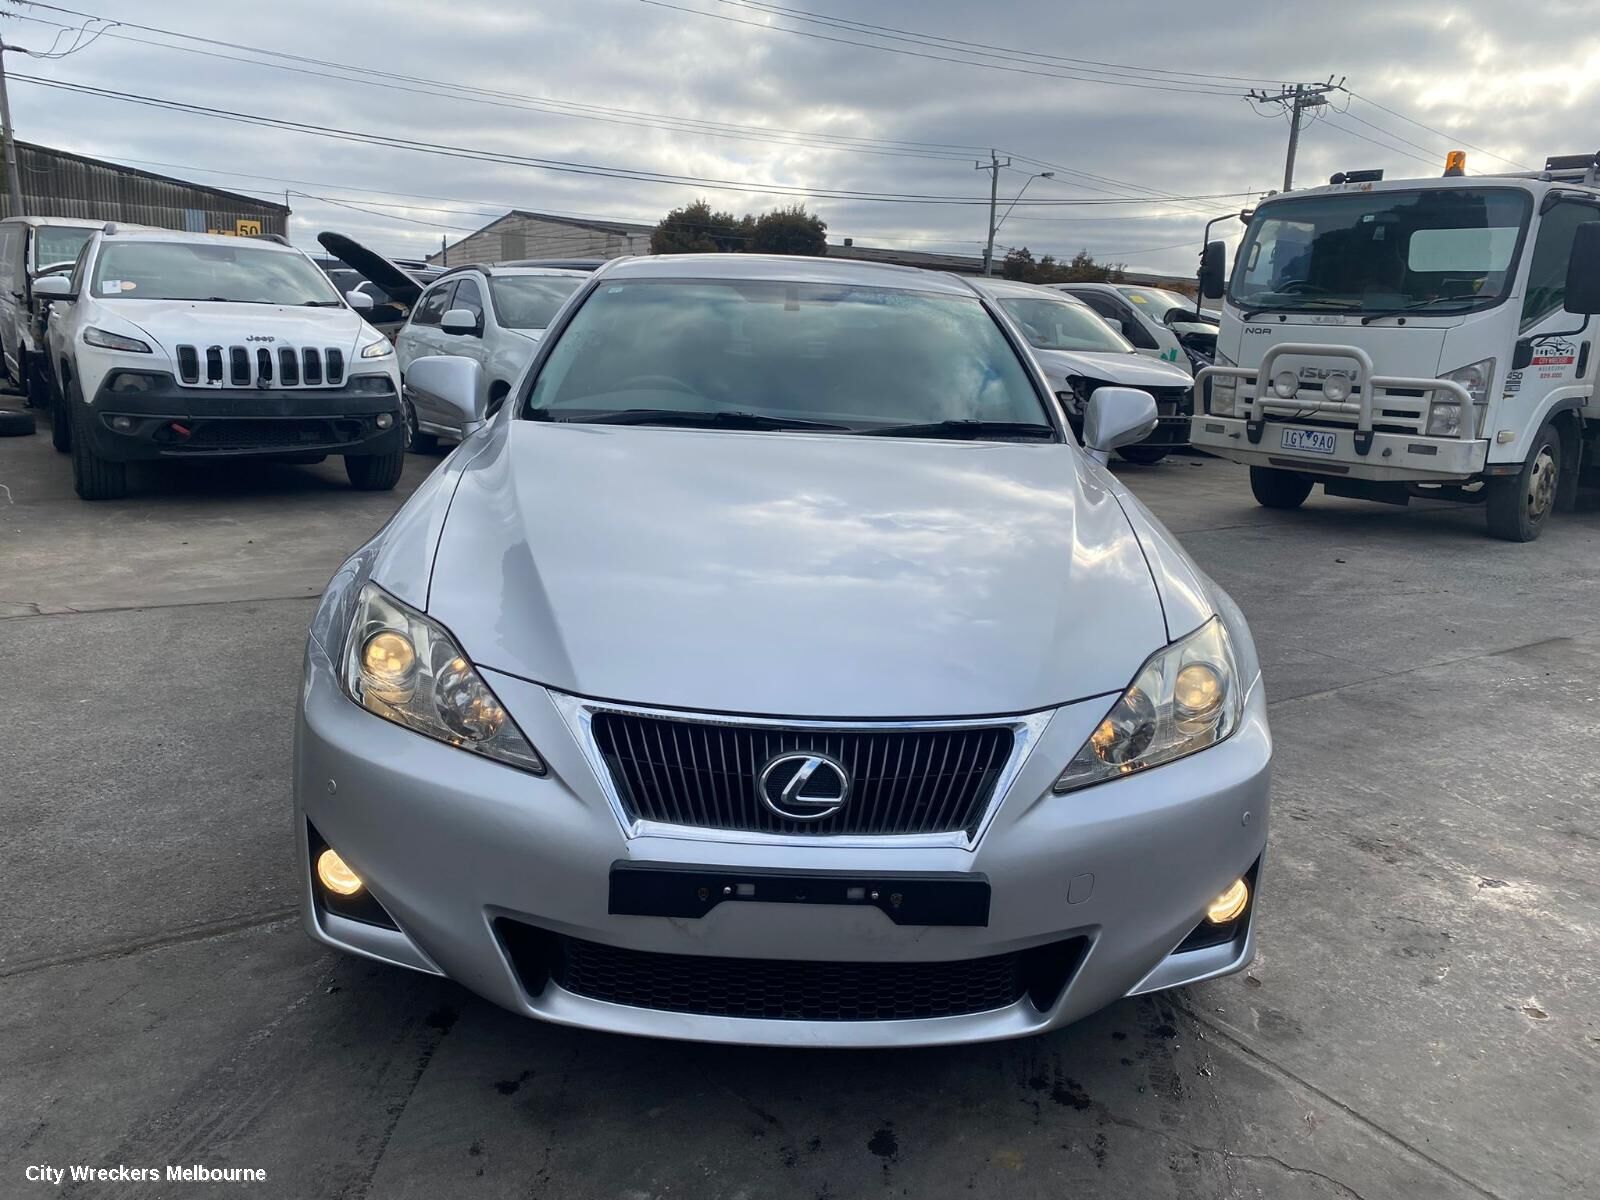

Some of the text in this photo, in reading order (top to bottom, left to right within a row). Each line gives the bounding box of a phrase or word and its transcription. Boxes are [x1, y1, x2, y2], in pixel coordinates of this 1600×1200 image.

[239, 225, 259, 236] 50
[246, 335, 275, 343] Jeep
[1506, 371, 1523, 380] 450
